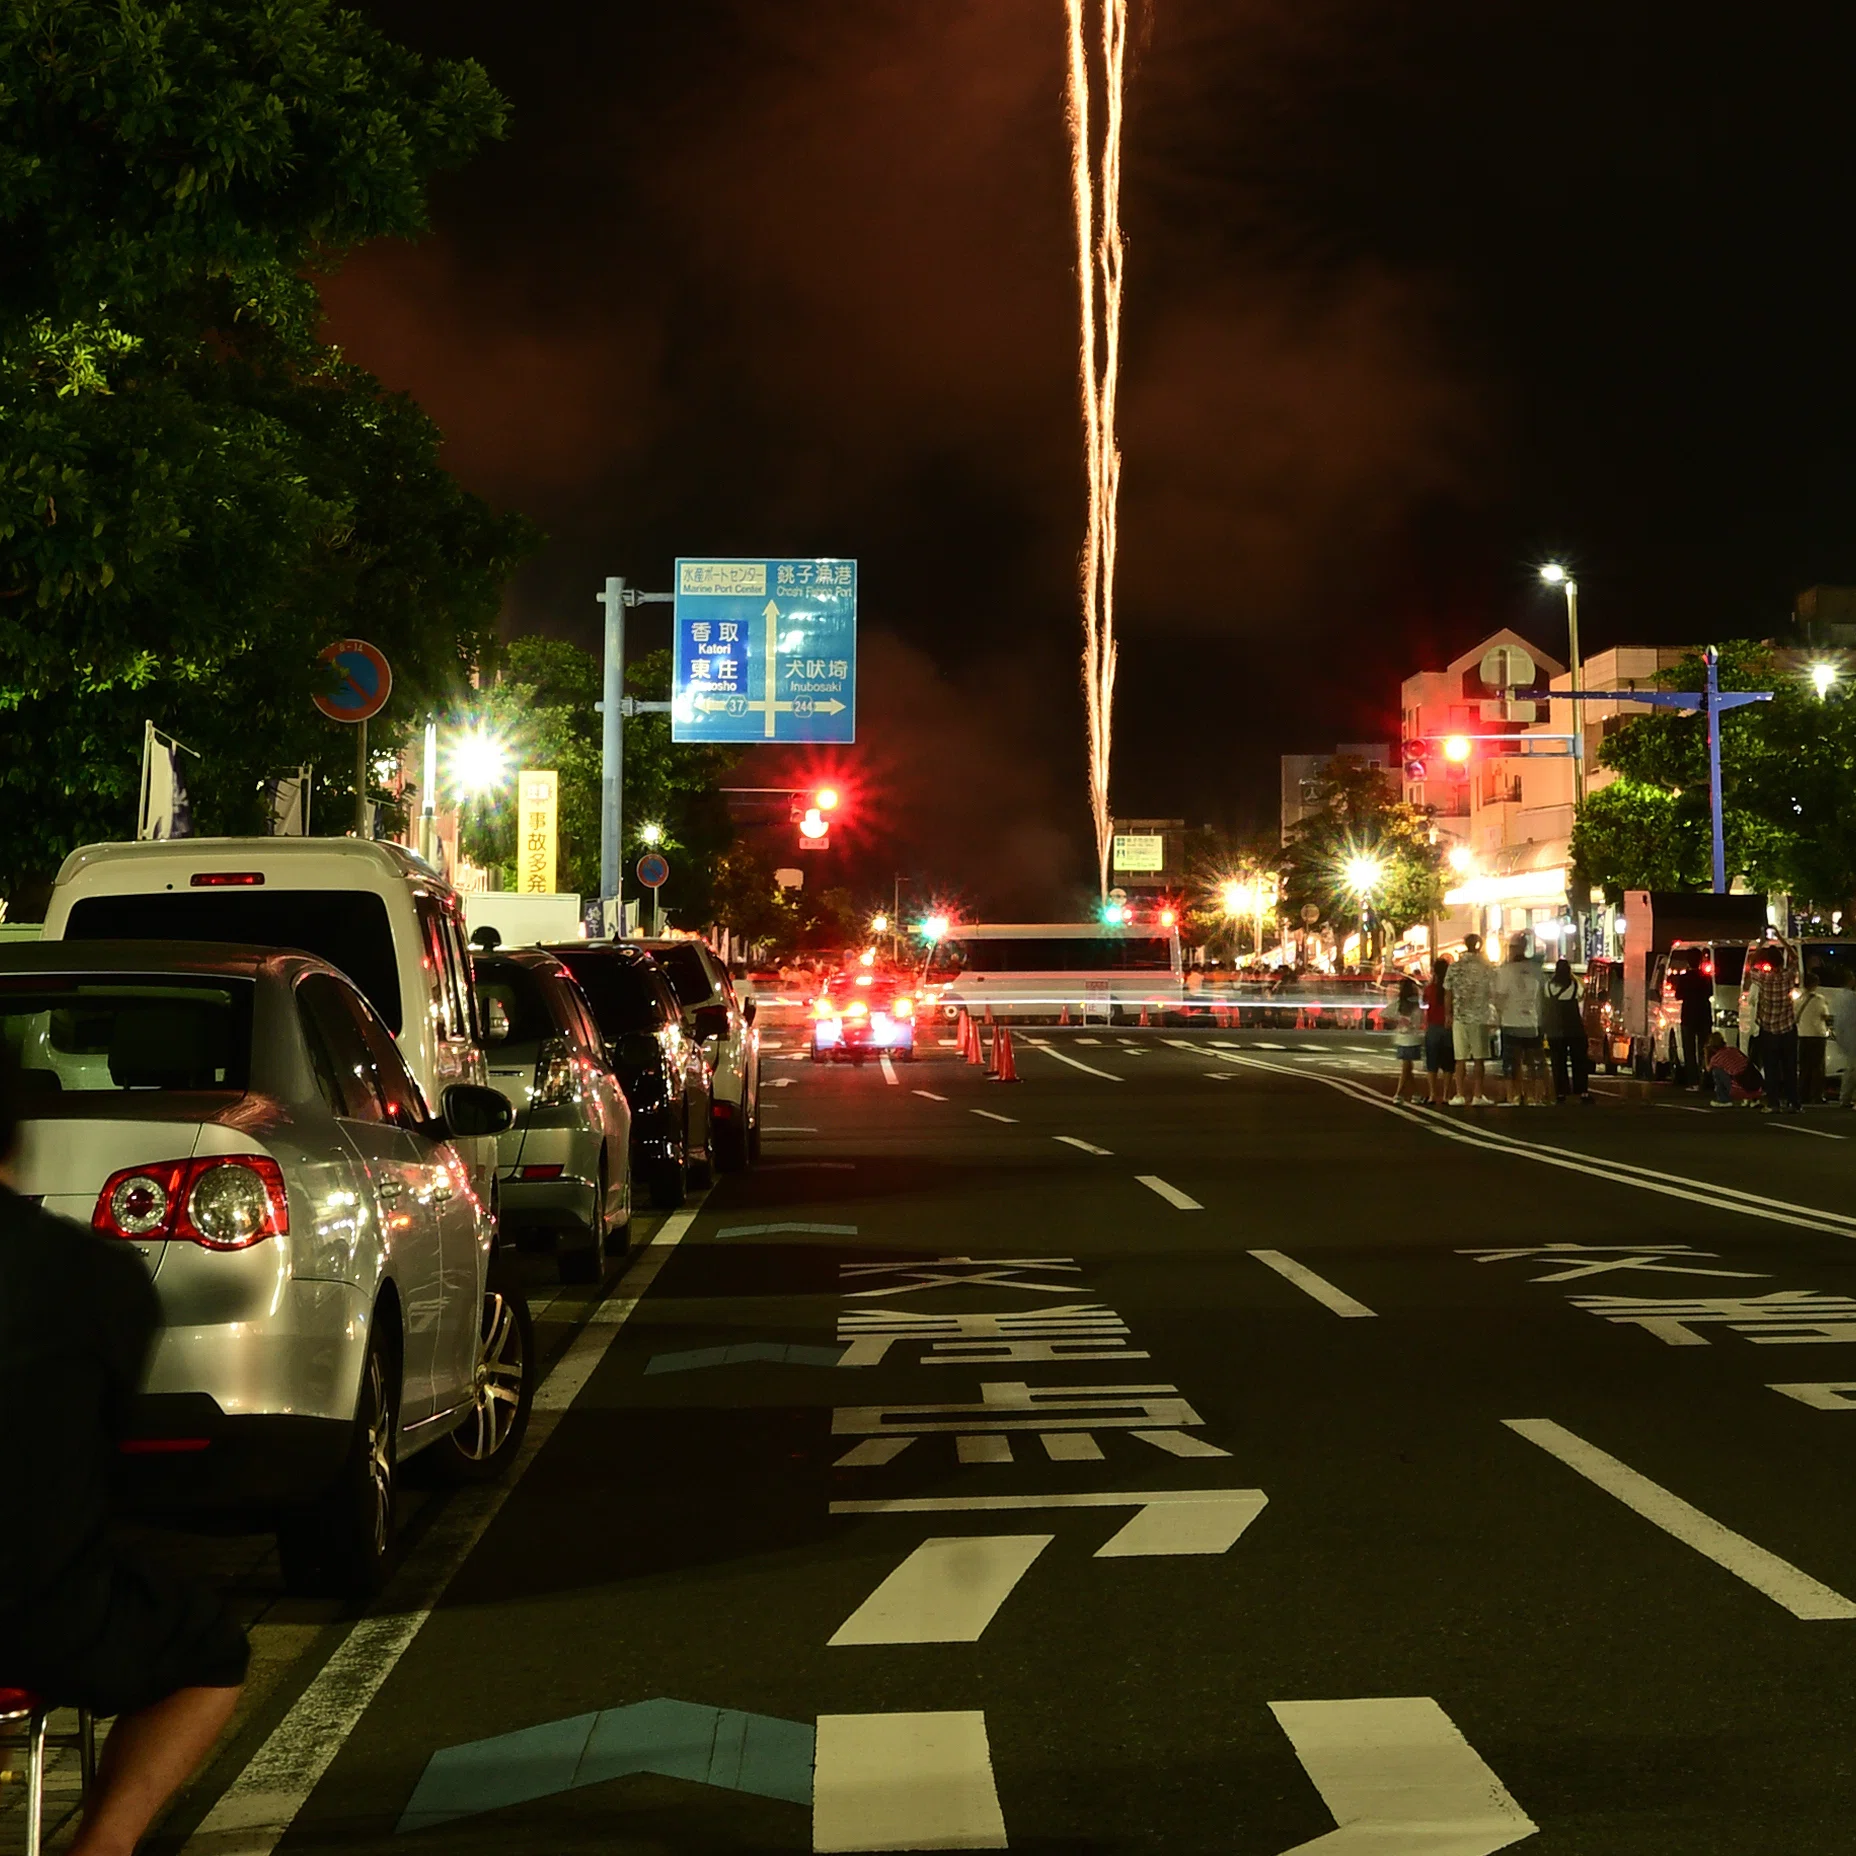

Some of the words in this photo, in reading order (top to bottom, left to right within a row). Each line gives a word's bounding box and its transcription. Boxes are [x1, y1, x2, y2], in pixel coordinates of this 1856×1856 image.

[683, 566, 763, 583] 水産ポートセンター
[776, 564, 852, 585] 銚子漁港
[683, 584, 712, 594] Marine
[714, 584, 733, 594] Port
[735, 584, 763, 594] Center
[691, 622, 739, 642] 香取
[698, 644, 732, 655] Katori
[690, 659, 739, 680] 東庄
[790, 681, 842, 692] Inubosaki
[728, 700, 744, 712] 37
[794, 700, 813, 712] 244
[527, 812, 547, 893] 事故多発
